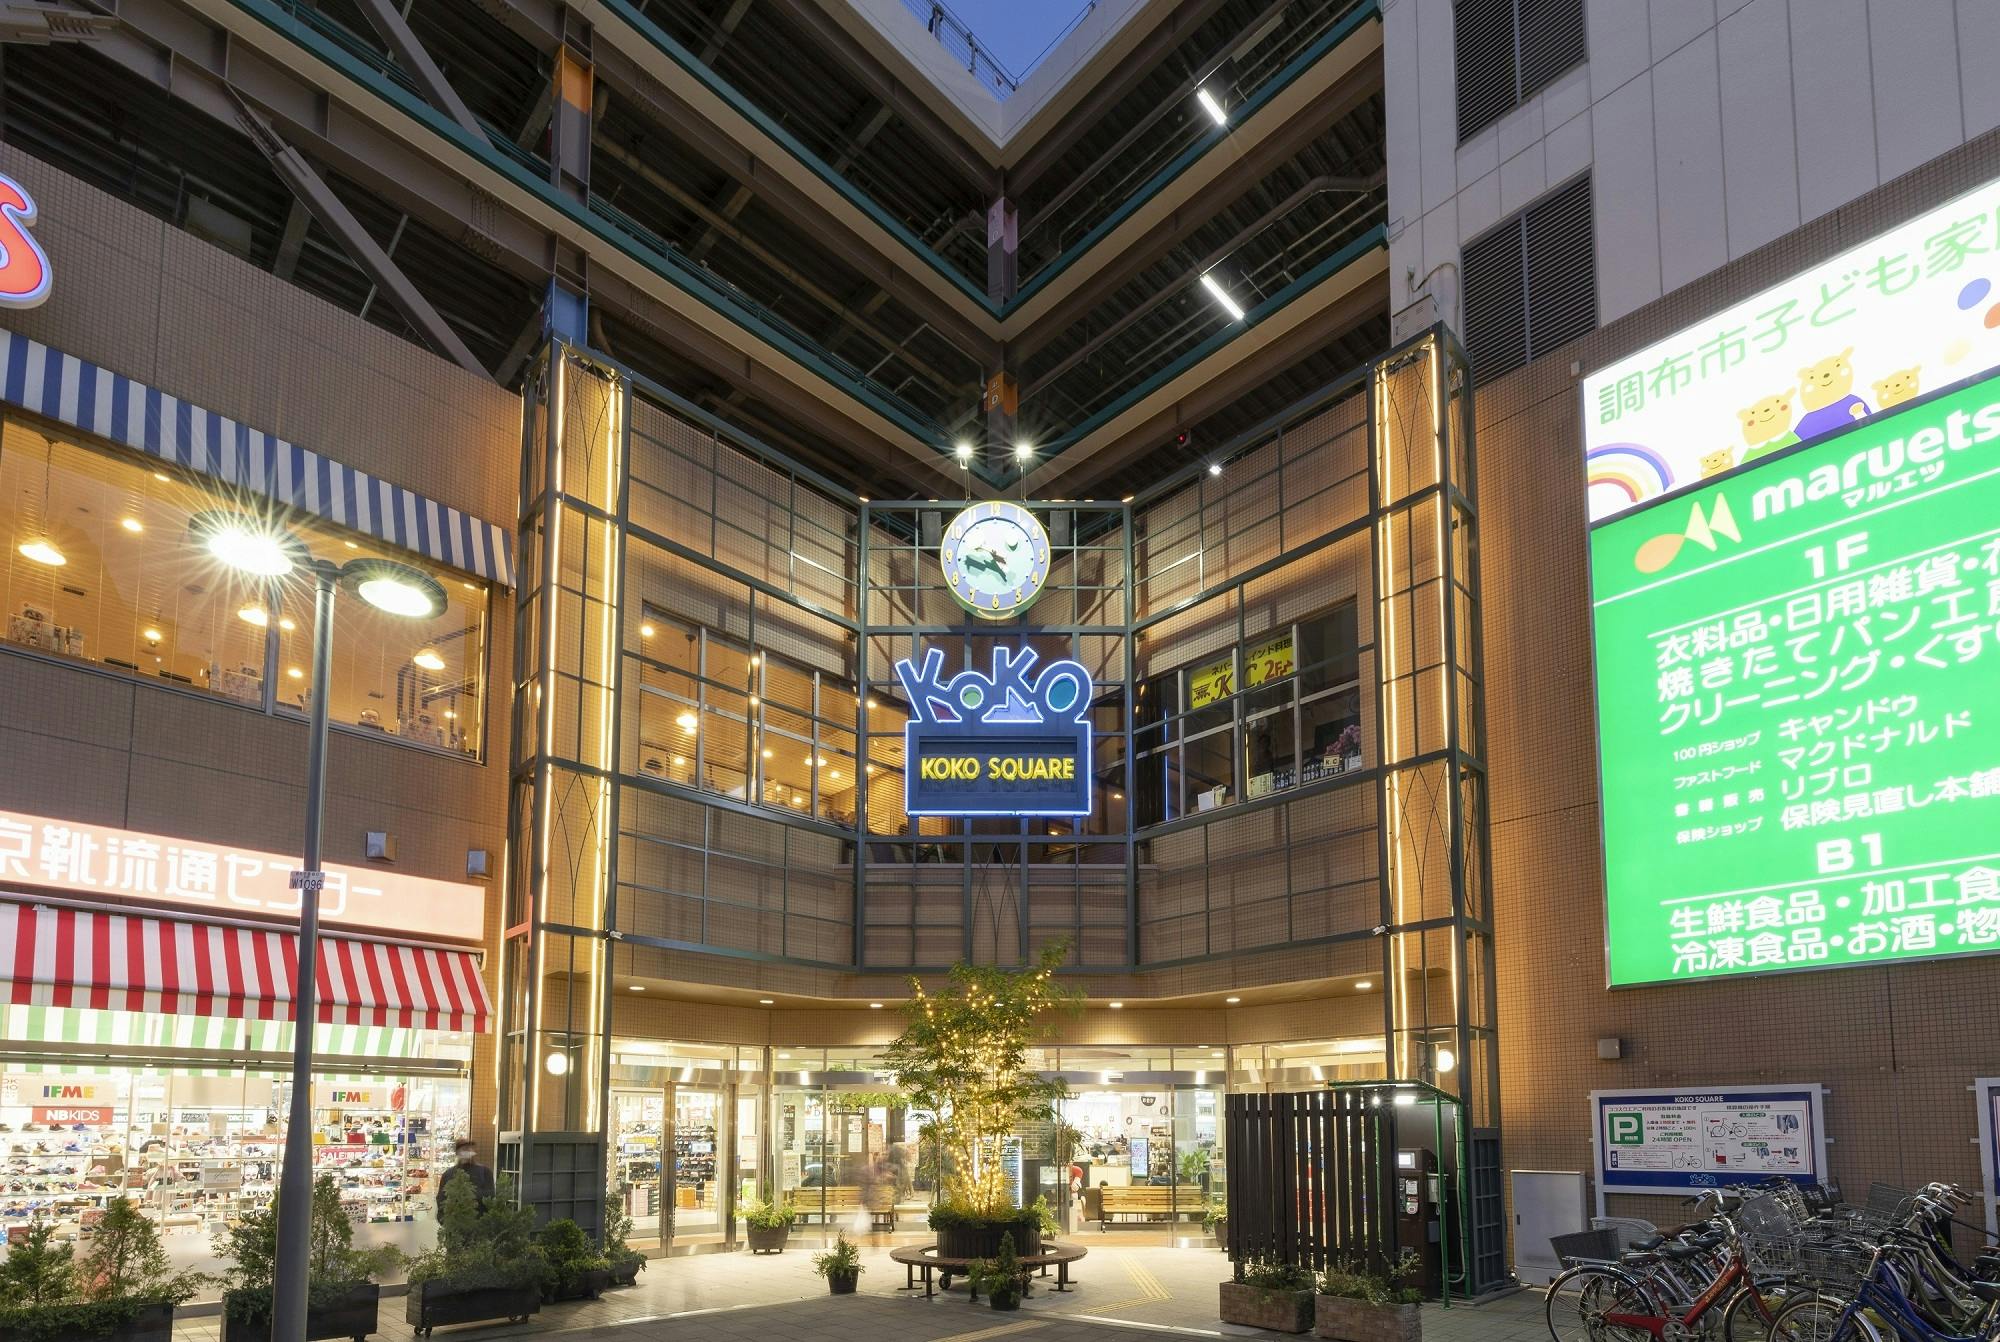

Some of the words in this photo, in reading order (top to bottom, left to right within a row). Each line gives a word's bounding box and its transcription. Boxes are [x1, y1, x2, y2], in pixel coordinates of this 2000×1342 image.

[1599, 205, 2000, 425] 調布市子ども家
[1842, 459, 1945, 508] マルエツ
[1805, 532, 1868, 579] 1F
[1660, 621, 2000, 735] クリーニング・くす
[1778, 694, 1918, 742] キャンドウ
[1778, 710, 1972, 770] マクドナルド
[921, 757, 980, 780] KOKO
[988, 757, 1075, 780] SQUARE
[1674, 760, 1762, 789] ファストフード
[1781, 763, 1872, 801] リブロ
[1816, 833, 1883, 875] B1
[291, 879, 322, 890] W1096
[43, 1085, 95, 1098] IFME
[332, 1091, 371, 1103] IFME
[1695, 1095, 1724, 1103] SQUARE
[1613, 1116, 1638, 1142] P
